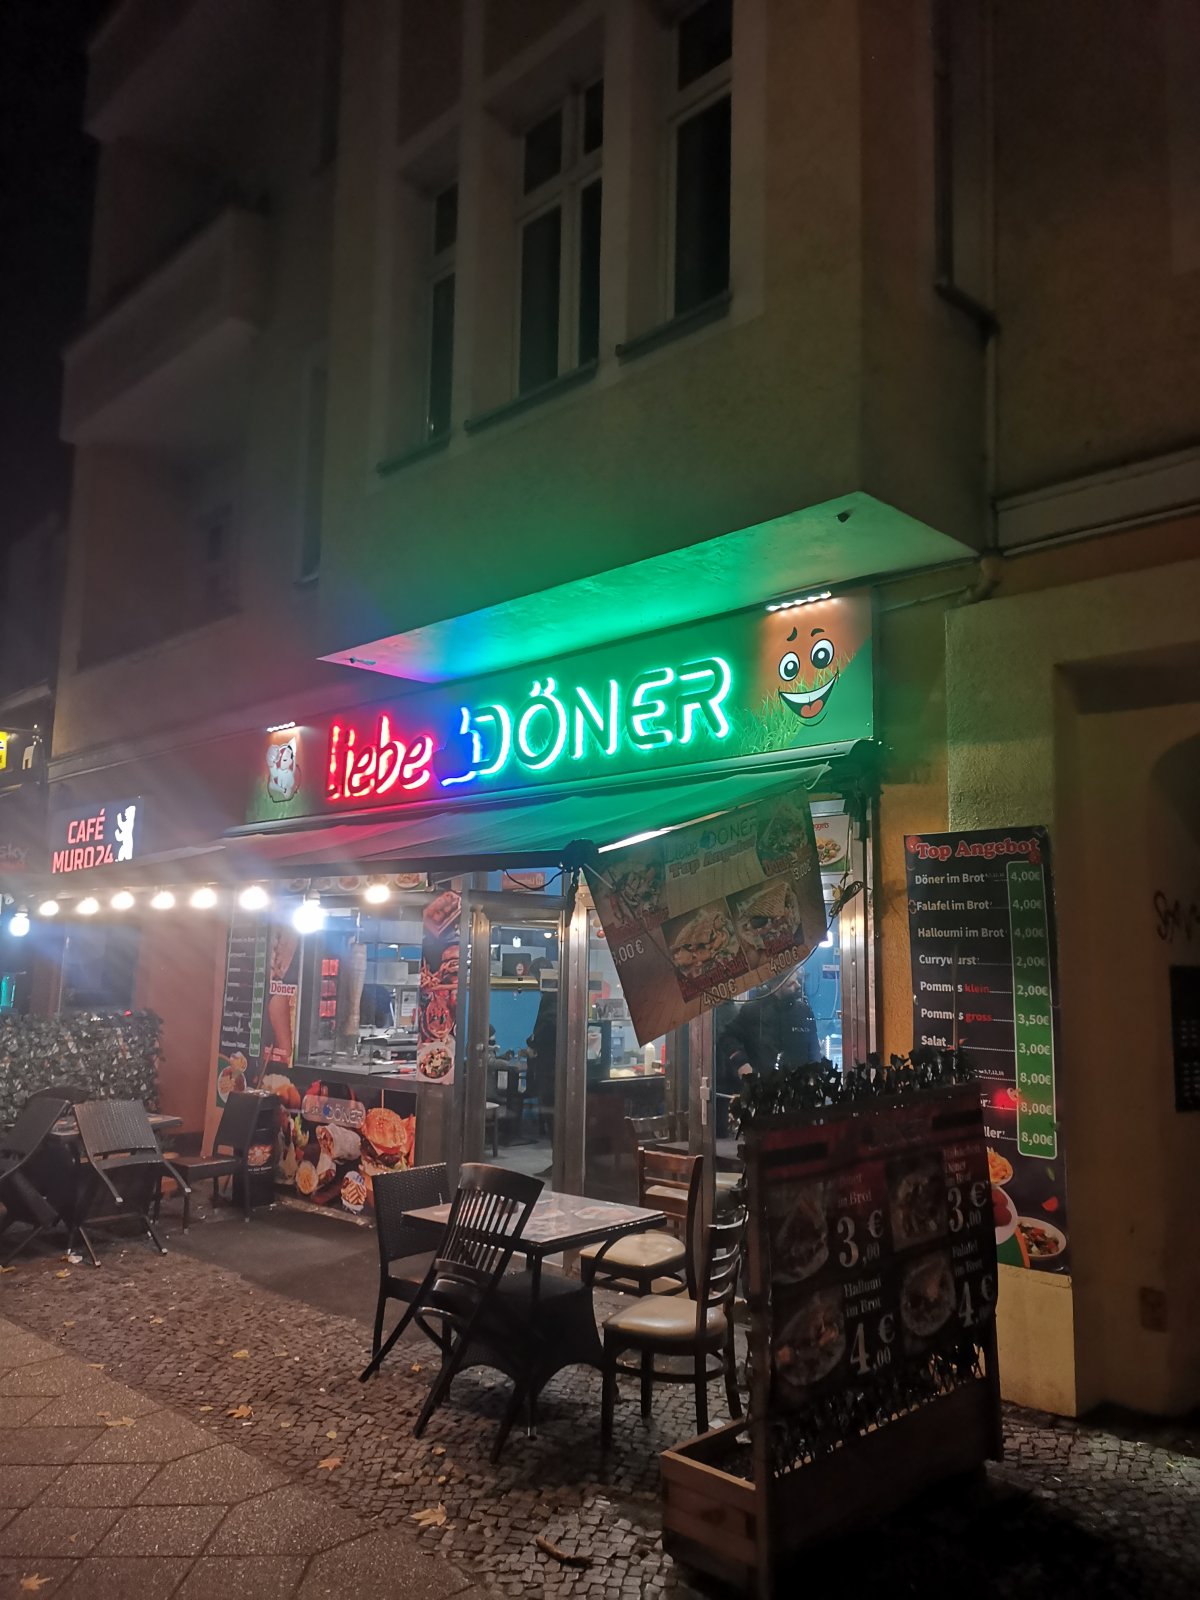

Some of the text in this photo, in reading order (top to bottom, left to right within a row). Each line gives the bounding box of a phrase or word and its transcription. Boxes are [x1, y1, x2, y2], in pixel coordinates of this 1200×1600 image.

[328, 655, 732, 800] liebe DÖNER
[66, 808, 106, 846] CAFÉ
[916, 838, 1040, 861] Top Angebot
[915, 874, 945, 885] Döner
[946, 873, 960, 884] im
[962, 873, 985, 883] Brot
[1011, 871, 1041, 882] 4,00€
[916, 900, 950, 911] Falafel
[952, 900, 965, 911] im
[1012, 900, 1042, 911] 4,00€
[918, 927, 963, 938] Halloumi
[965, 926, 979, 938] im
[1014, 927, 1046, 939] 4,00€
[1016, 957, 1047, 968] 2,00€
[271, 982, 296, 995] Döner
[964, 983, 990, 993] klein
[1017, 985, 1048, 997] 2,00€
[965, 1013, 993, 1024] gross
[1018, 1013, 1050, 1026] 3,50€
[921, 1035, 1051, 1056] Salat 3,00€
[1020, 1072, 1052, 1085] 8,00€
[1020, 1102, 1053, 1116] 8,00€
[1021, 1132, 1054, 1146] 8,00€
